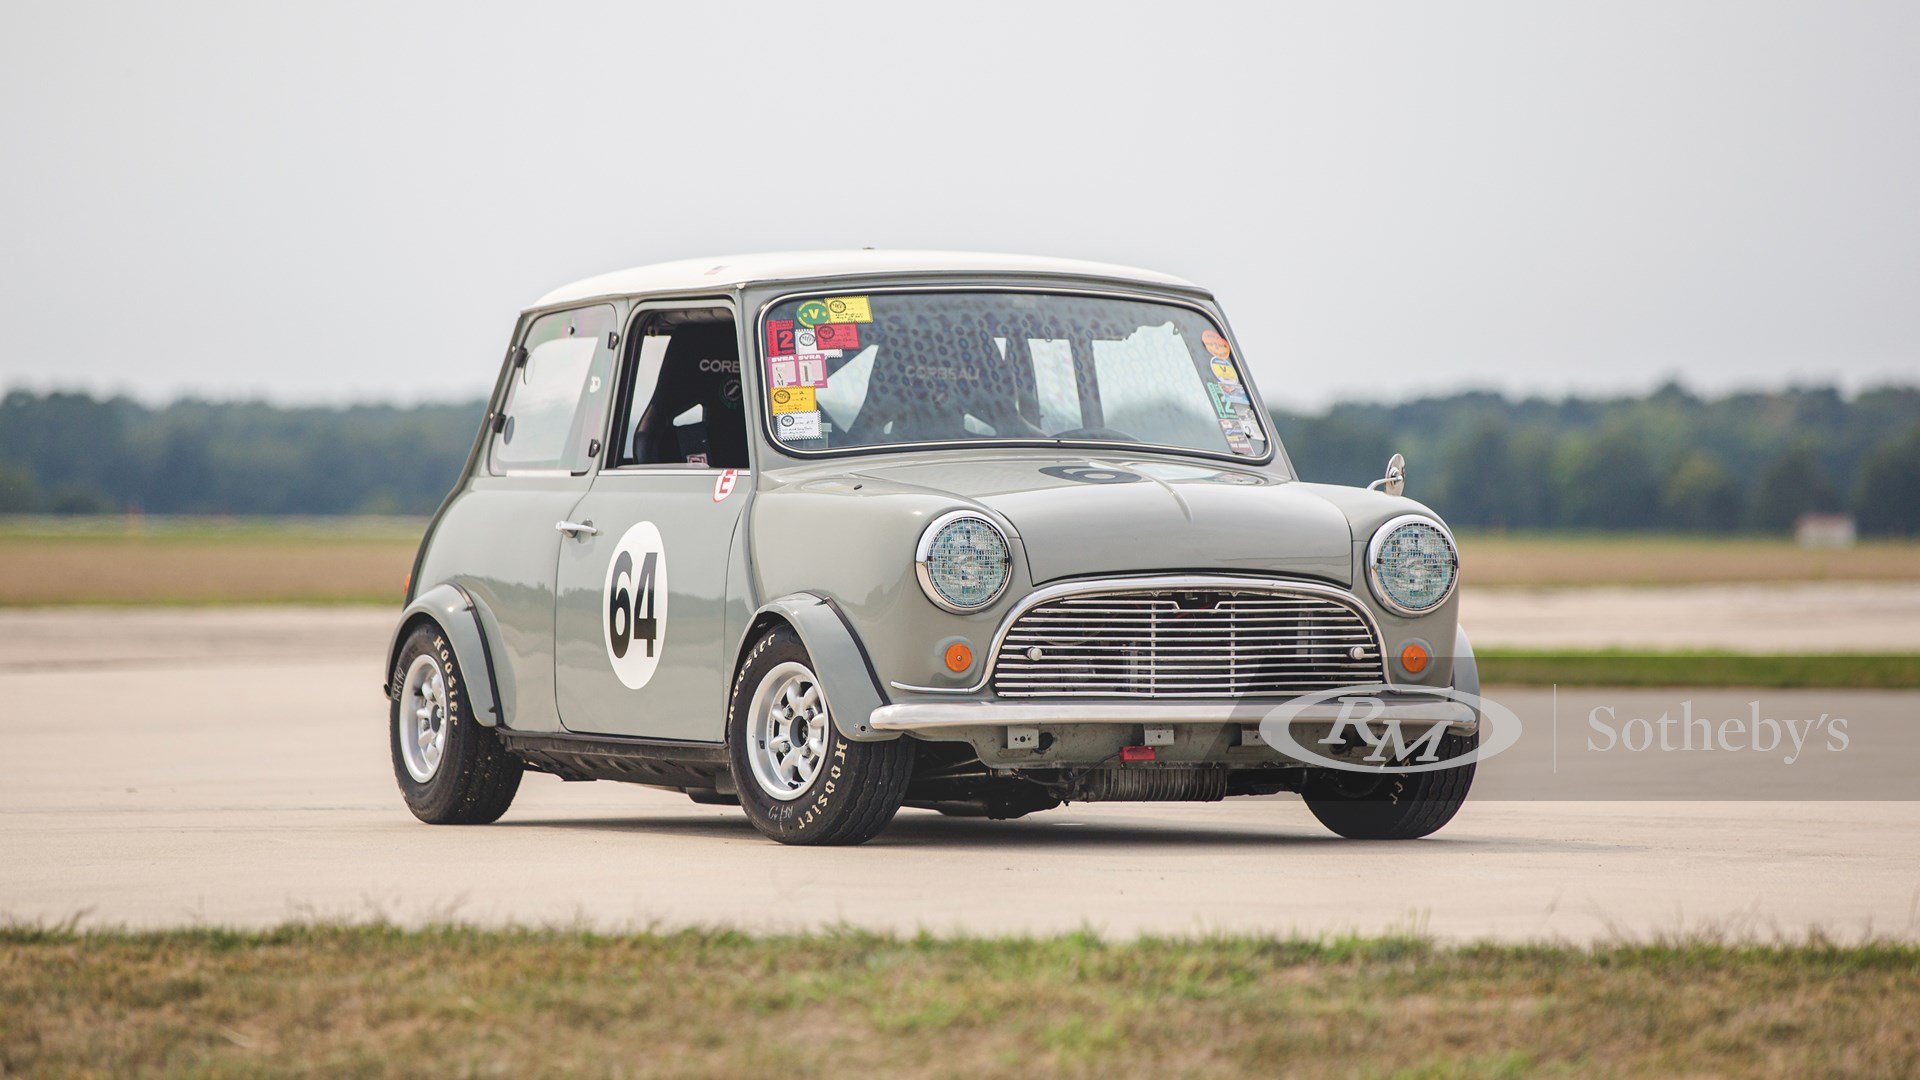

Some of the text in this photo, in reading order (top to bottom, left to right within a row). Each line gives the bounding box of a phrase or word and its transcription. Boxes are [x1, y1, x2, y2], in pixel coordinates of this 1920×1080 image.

[779, 330, 795, 349] 2
[771, 355, 795, 363] SVRA
[719, 469, 735, 494] E
[609, 550, 659, 660] 64
